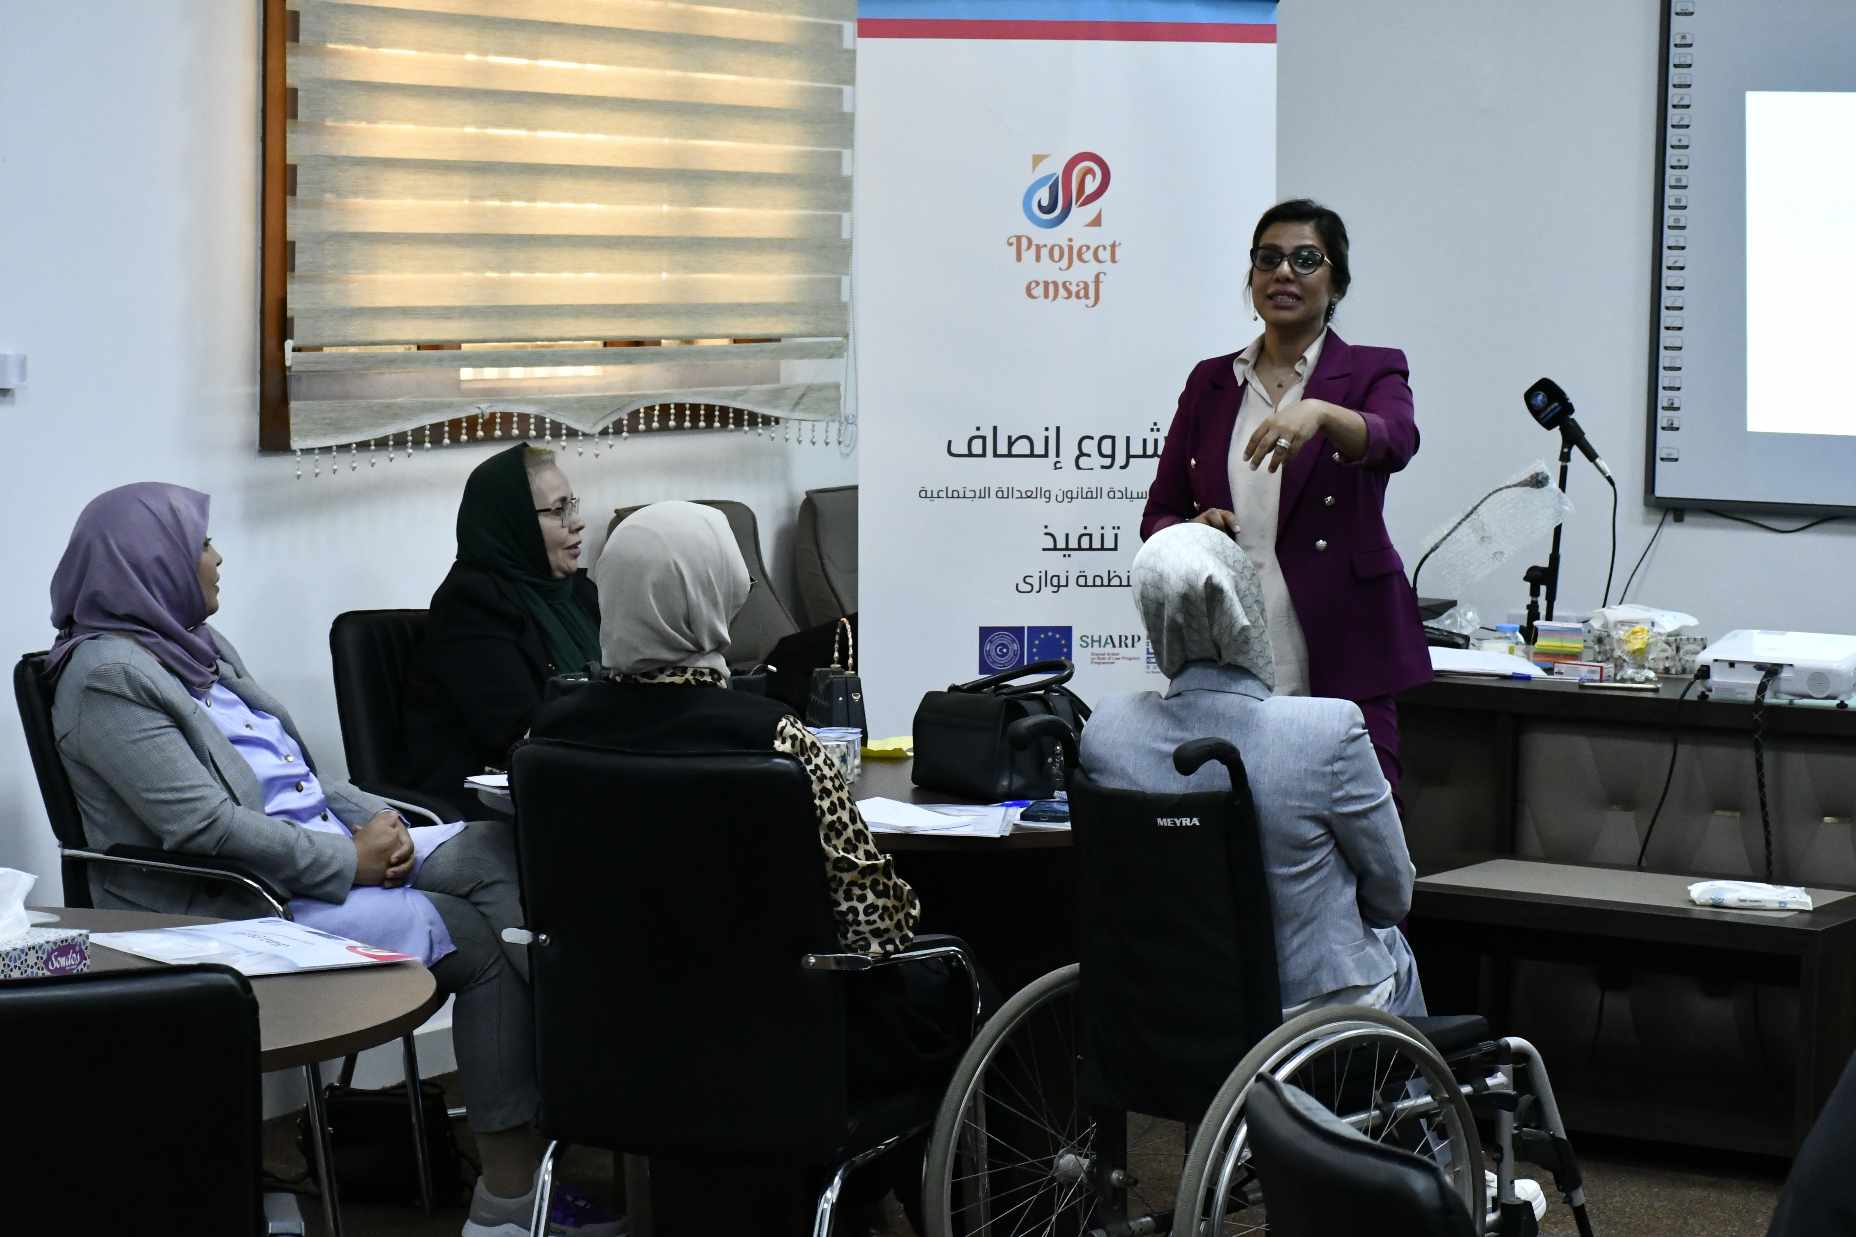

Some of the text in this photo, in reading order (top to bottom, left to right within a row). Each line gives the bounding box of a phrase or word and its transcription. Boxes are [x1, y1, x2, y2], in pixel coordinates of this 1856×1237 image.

[1007, 234, 1121, 272] Project
[1025, 271, 1107, 308] ensaf
[946, 422, 1168, 471] شروع إنصاف
[918, 485, 991, 502] الاجتماعية
[995, 486, 1051, 503] والعدالة
[1055, 486, 1103, 504] القانون
[1042, 524, 1121, 558] تنفيذ
[1075, 570, 1133, 588] نظمة
[1079, 634, 1141, 649] SHARP
[1156, 817, 1201, 827] MEYRA
